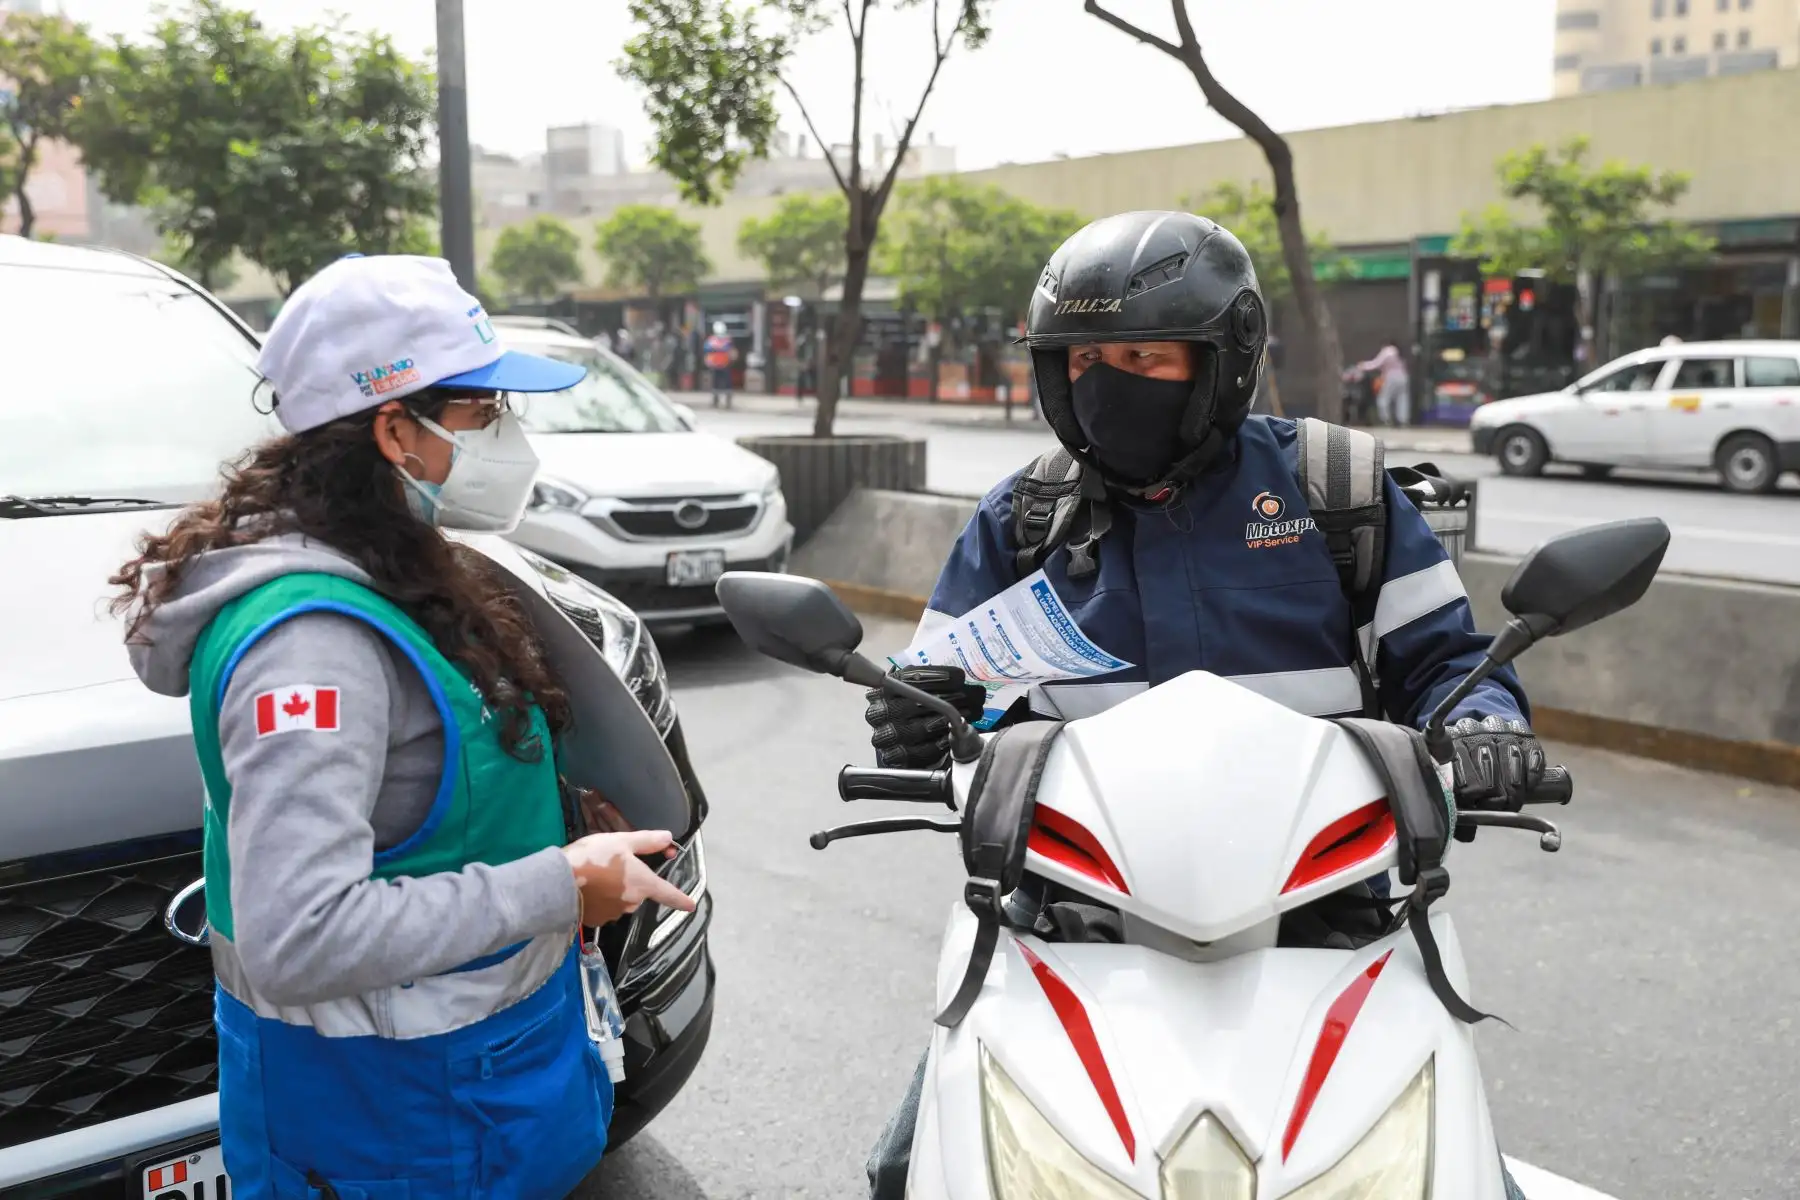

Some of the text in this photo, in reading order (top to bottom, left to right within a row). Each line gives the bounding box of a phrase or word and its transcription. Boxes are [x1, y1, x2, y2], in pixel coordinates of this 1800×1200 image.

[1039, 598, 1052, 614] USO
[1048, 614, 1077, 649] ADECUADO
[1044, 592, 1068, 626] PAPELETA
